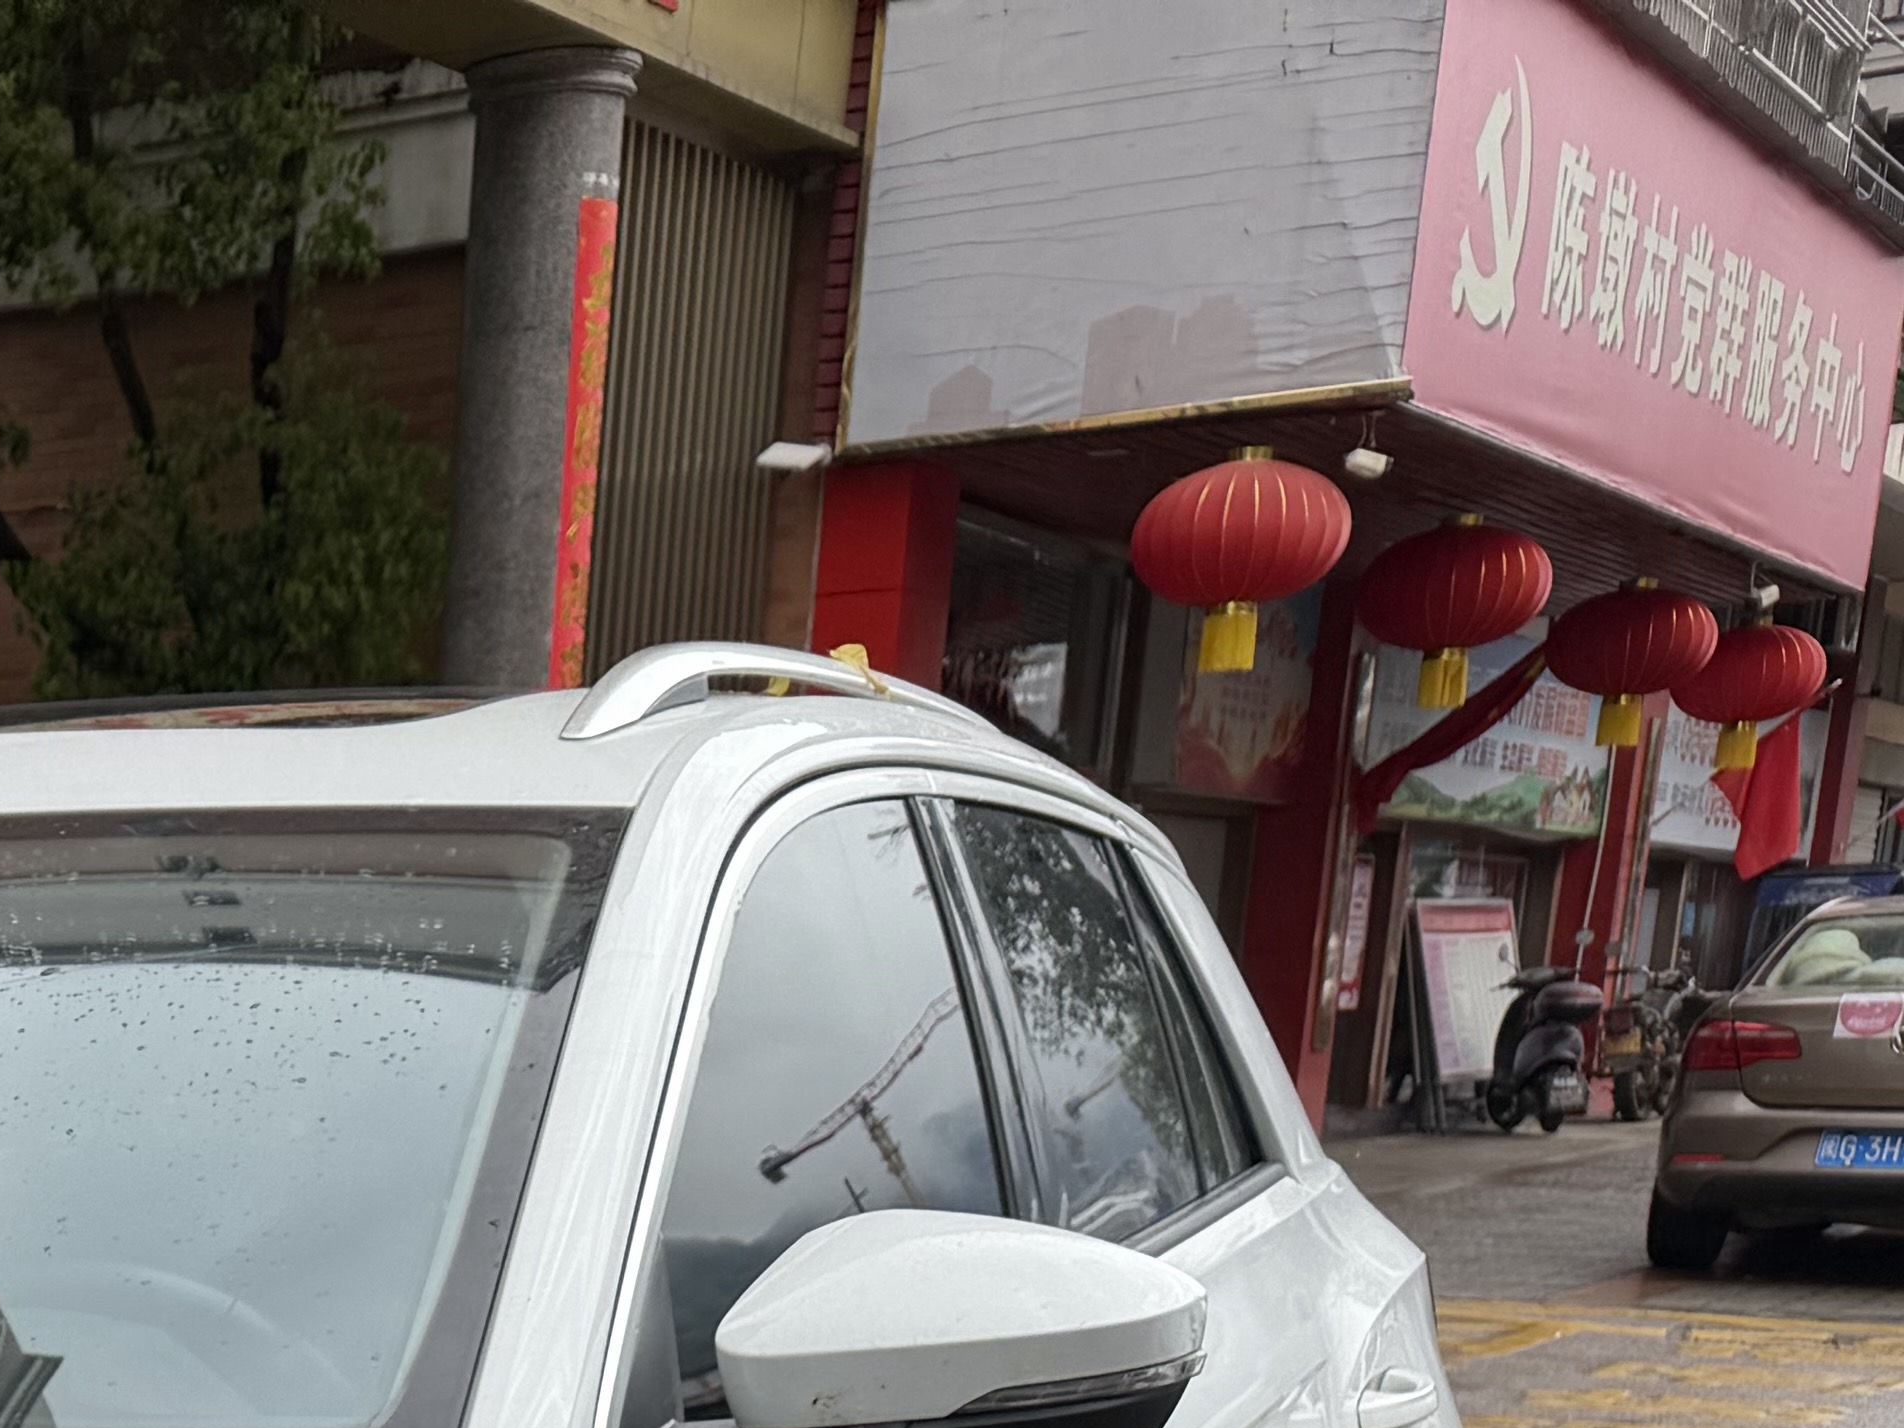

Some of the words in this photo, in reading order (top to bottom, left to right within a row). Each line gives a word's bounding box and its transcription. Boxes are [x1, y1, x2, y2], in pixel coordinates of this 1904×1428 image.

[1539, 140, 1866, 475] 陈墩村党群服务中心
[1821, 1134, 1904, 1166] 闽G·3H
